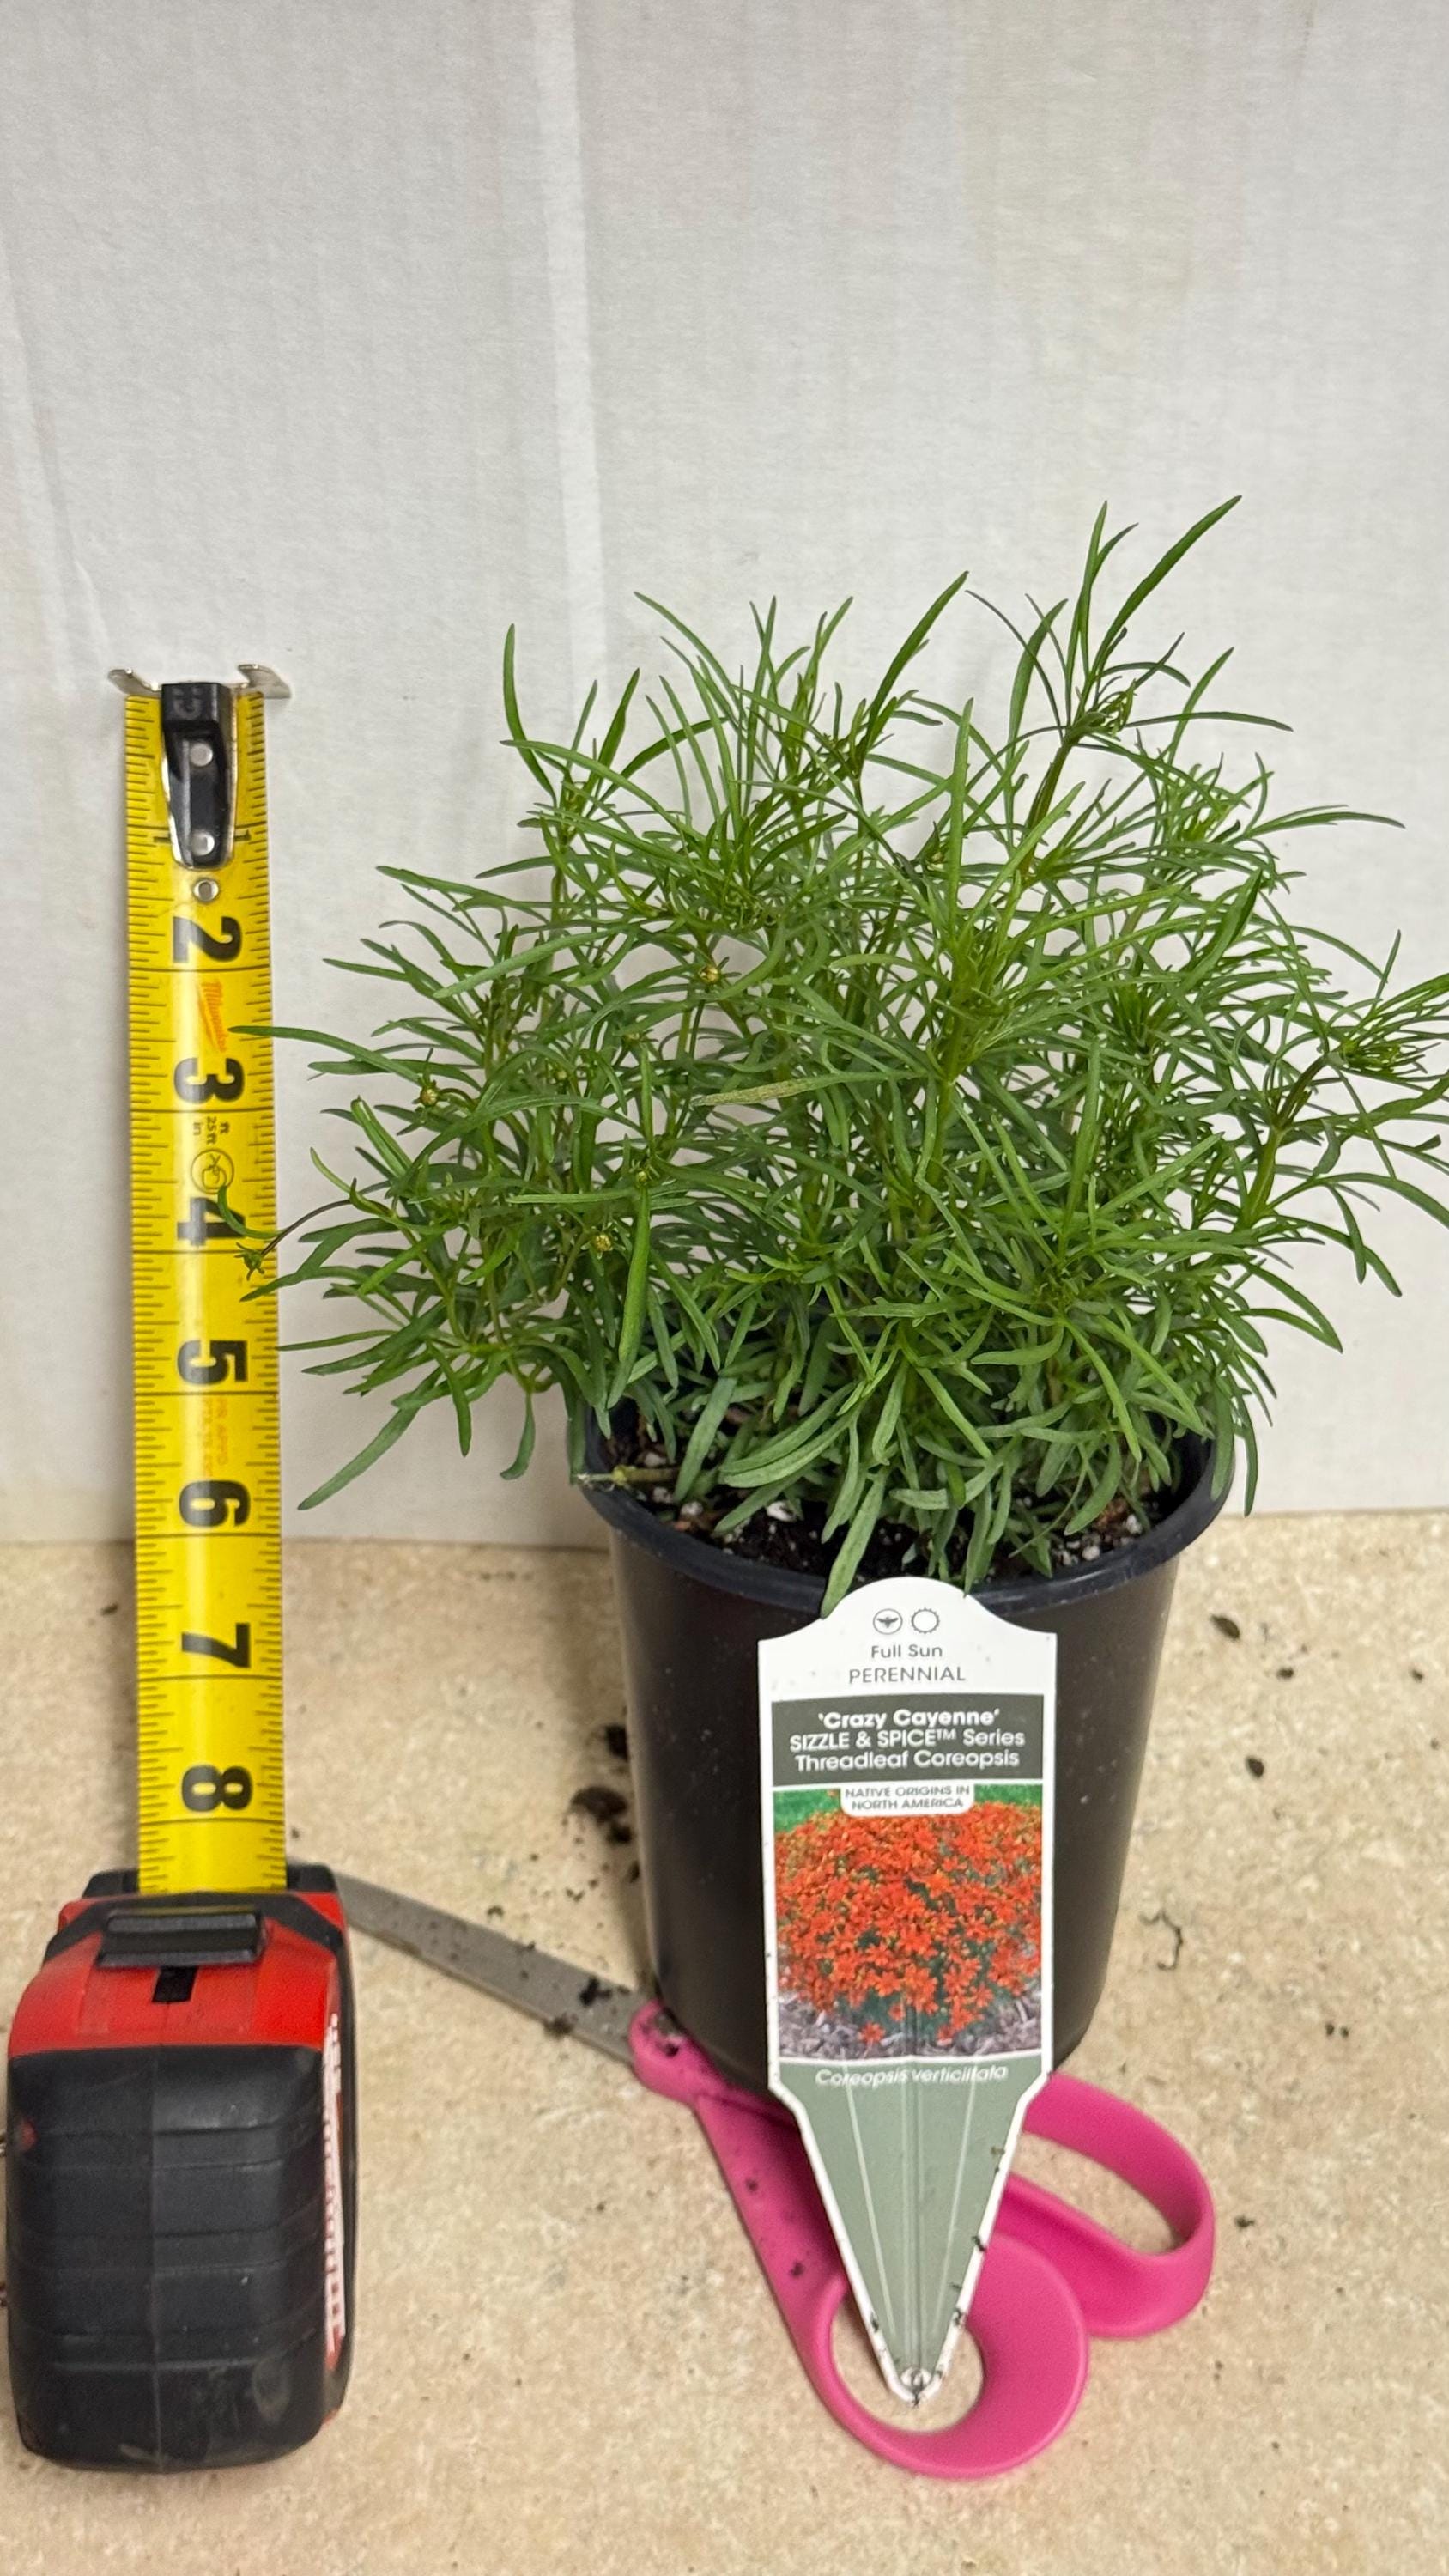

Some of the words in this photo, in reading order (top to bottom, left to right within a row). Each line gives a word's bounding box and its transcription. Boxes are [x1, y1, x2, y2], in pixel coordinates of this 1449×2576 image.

[173, 916, 242, 963] 2
[173, 1058, 245, 1104] 3
[177, 1197, 246, 1247] 4
[177, 1340, 248, 1386] 5
[179, 1479, 252, 1528] 6
[181, 1622, 251, 1668] 7
[870, 1645, 902, 1659] Full
[908, 1643, 943, 1658] Sun
[848, 1665, 967, 1684] PERENNIAL
[789, 1731, 851, 1753] SIZZLE
[855, 1732, 872, 1749] &
[962, 1728, 1025, 1747] Series
[794, 1750, 909, 1772] Threadleaf
[913, 1748, 1021, 1771] Coreopsis
[181, 1764, 254, 1813] 8
[845, 1787, 891, 1798] NATIVE
[895, 1785, 952, 1796] ORIGINS
[956, 1785, 970, 1795] IN
[852, 1799, 898, 1810] NORTH
[902, 1797, 963, 1808] AMERICA
[815, 2067, 908, 2089] Coreopsis
[910, 2064, 1009, 2084] verticillata
